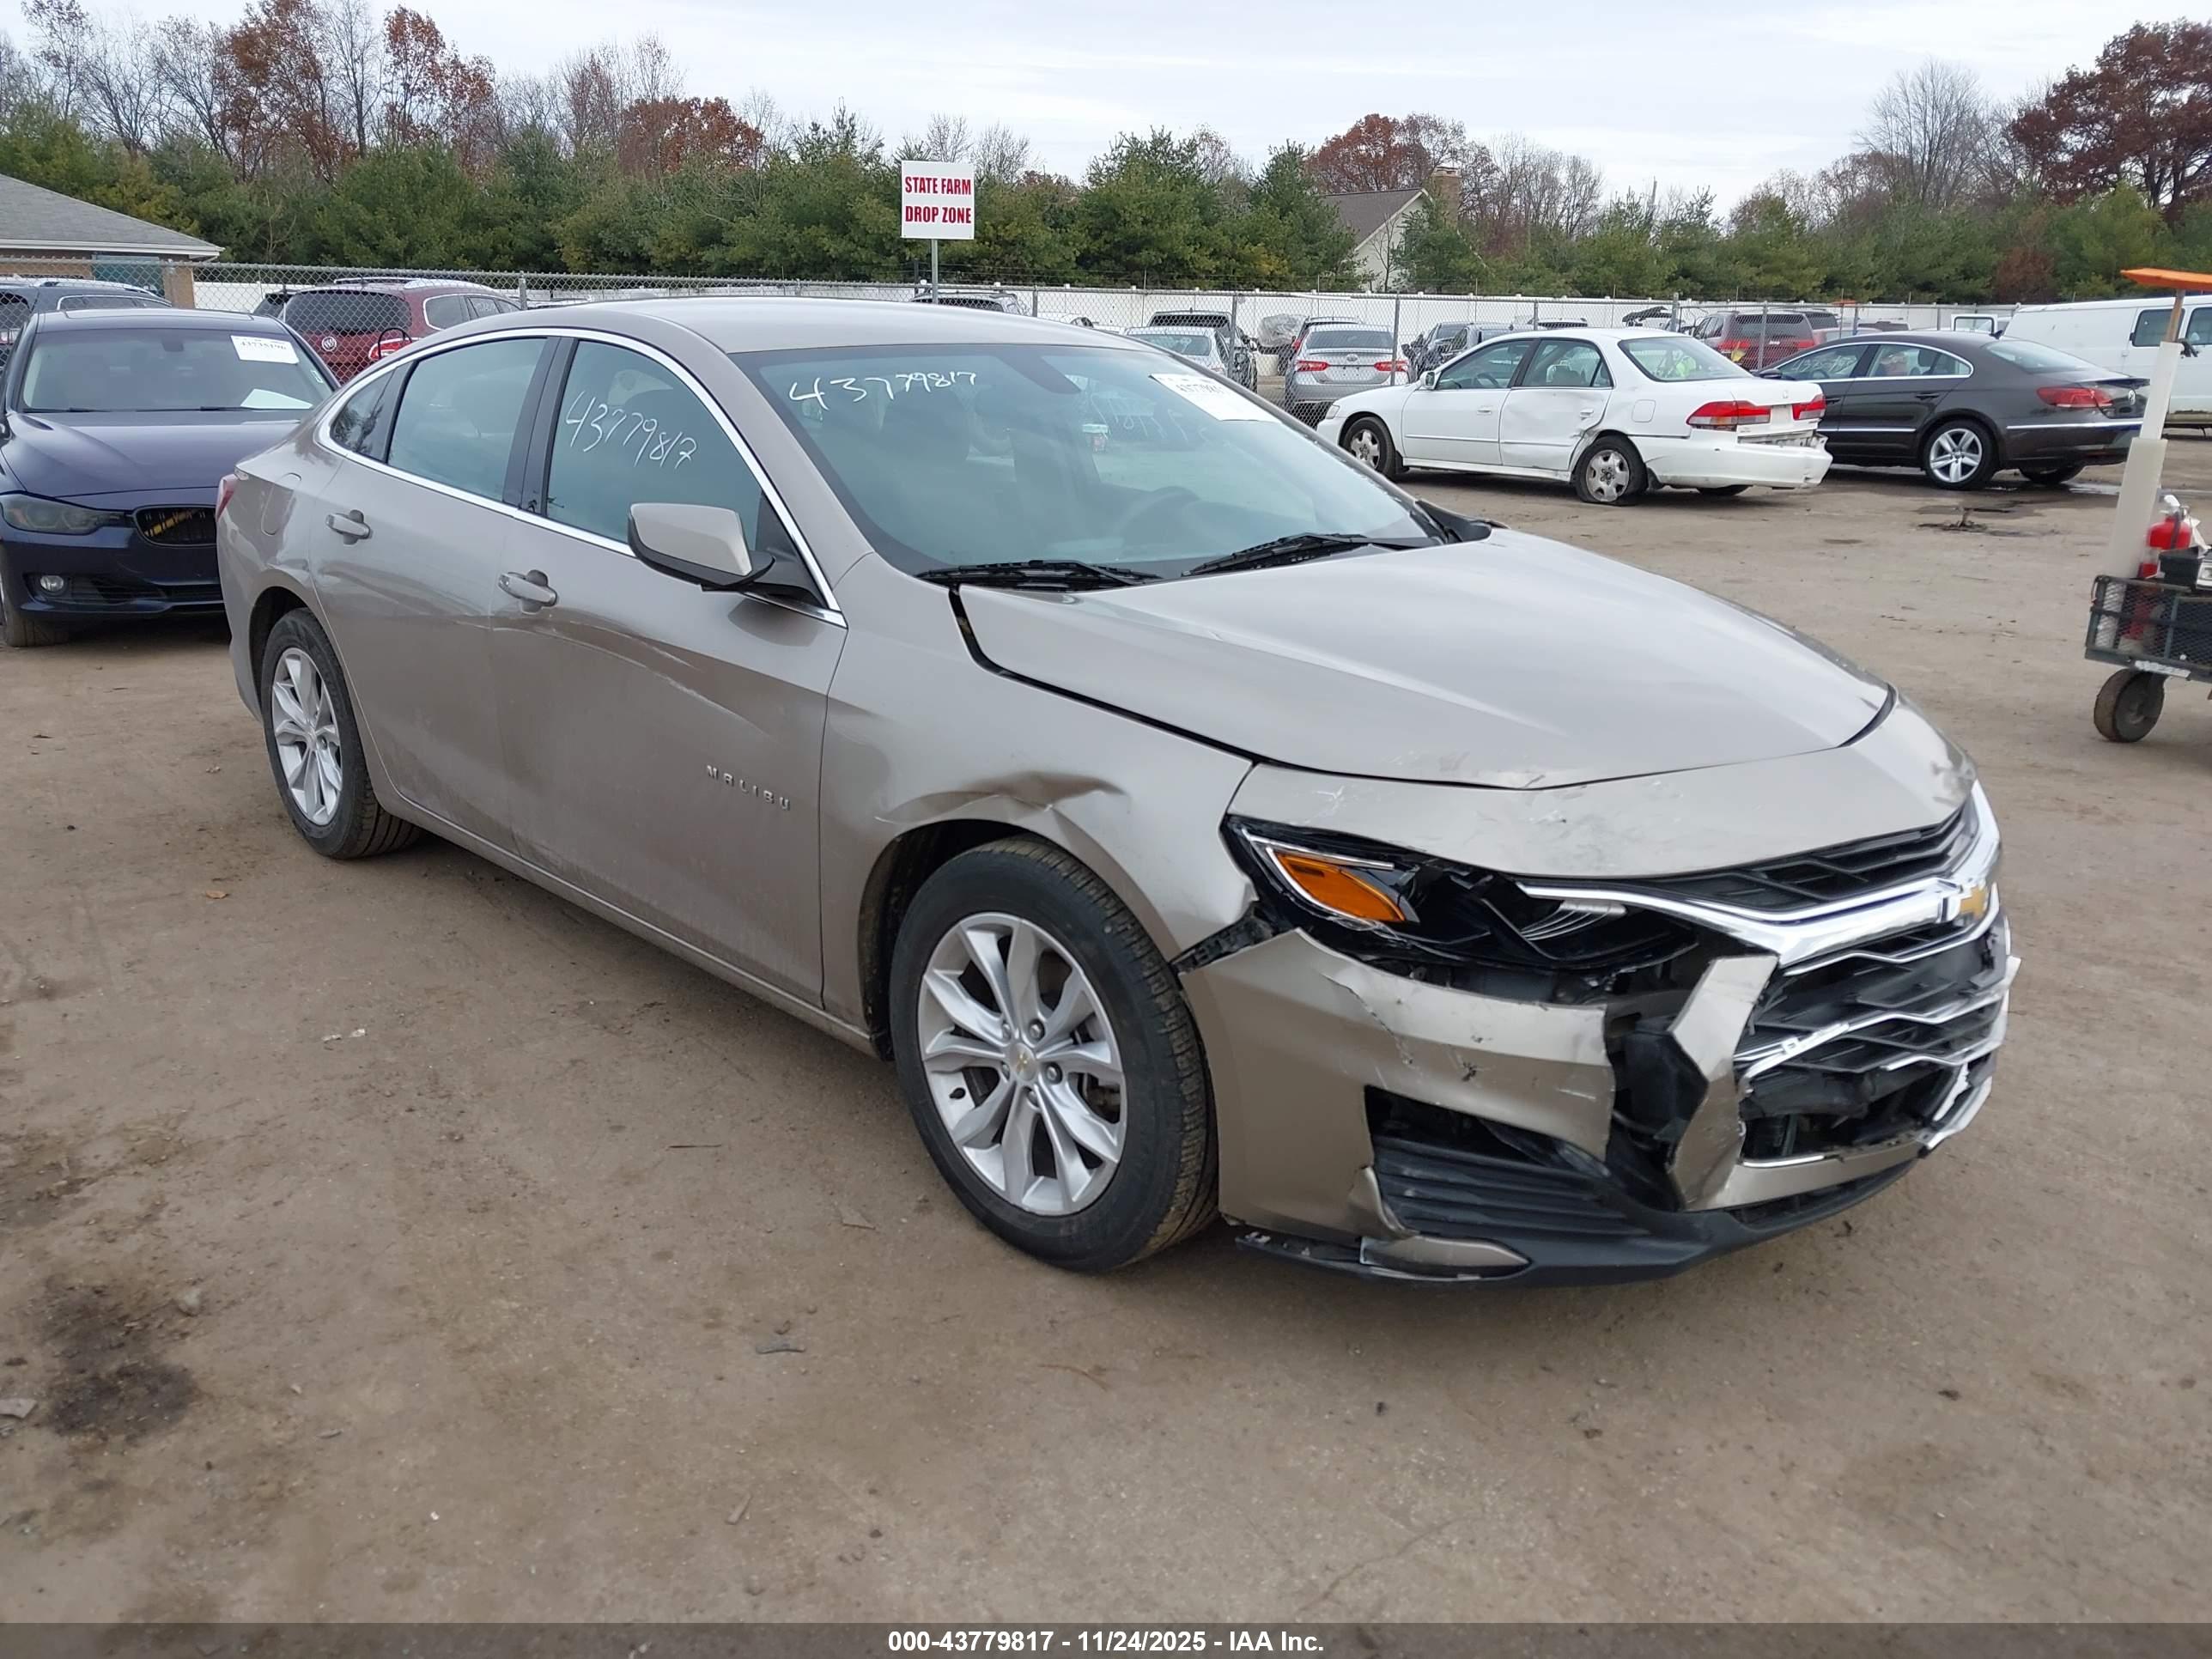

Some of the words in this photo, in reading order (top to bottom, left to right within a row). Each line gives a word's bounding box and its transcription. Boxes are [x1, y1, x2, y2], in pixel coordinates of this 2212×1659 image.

[905, 176, 939, 194] STATE
[941, 178, 972, 196] FARM
[905, 205, 939, 223] DROP
[942, 206, 972, 224] ZONE
[788, 370, 977, 410] 43779817
[565, 390, 698, 470] 43779817
[707, 764, 791, 811] MALIBU
